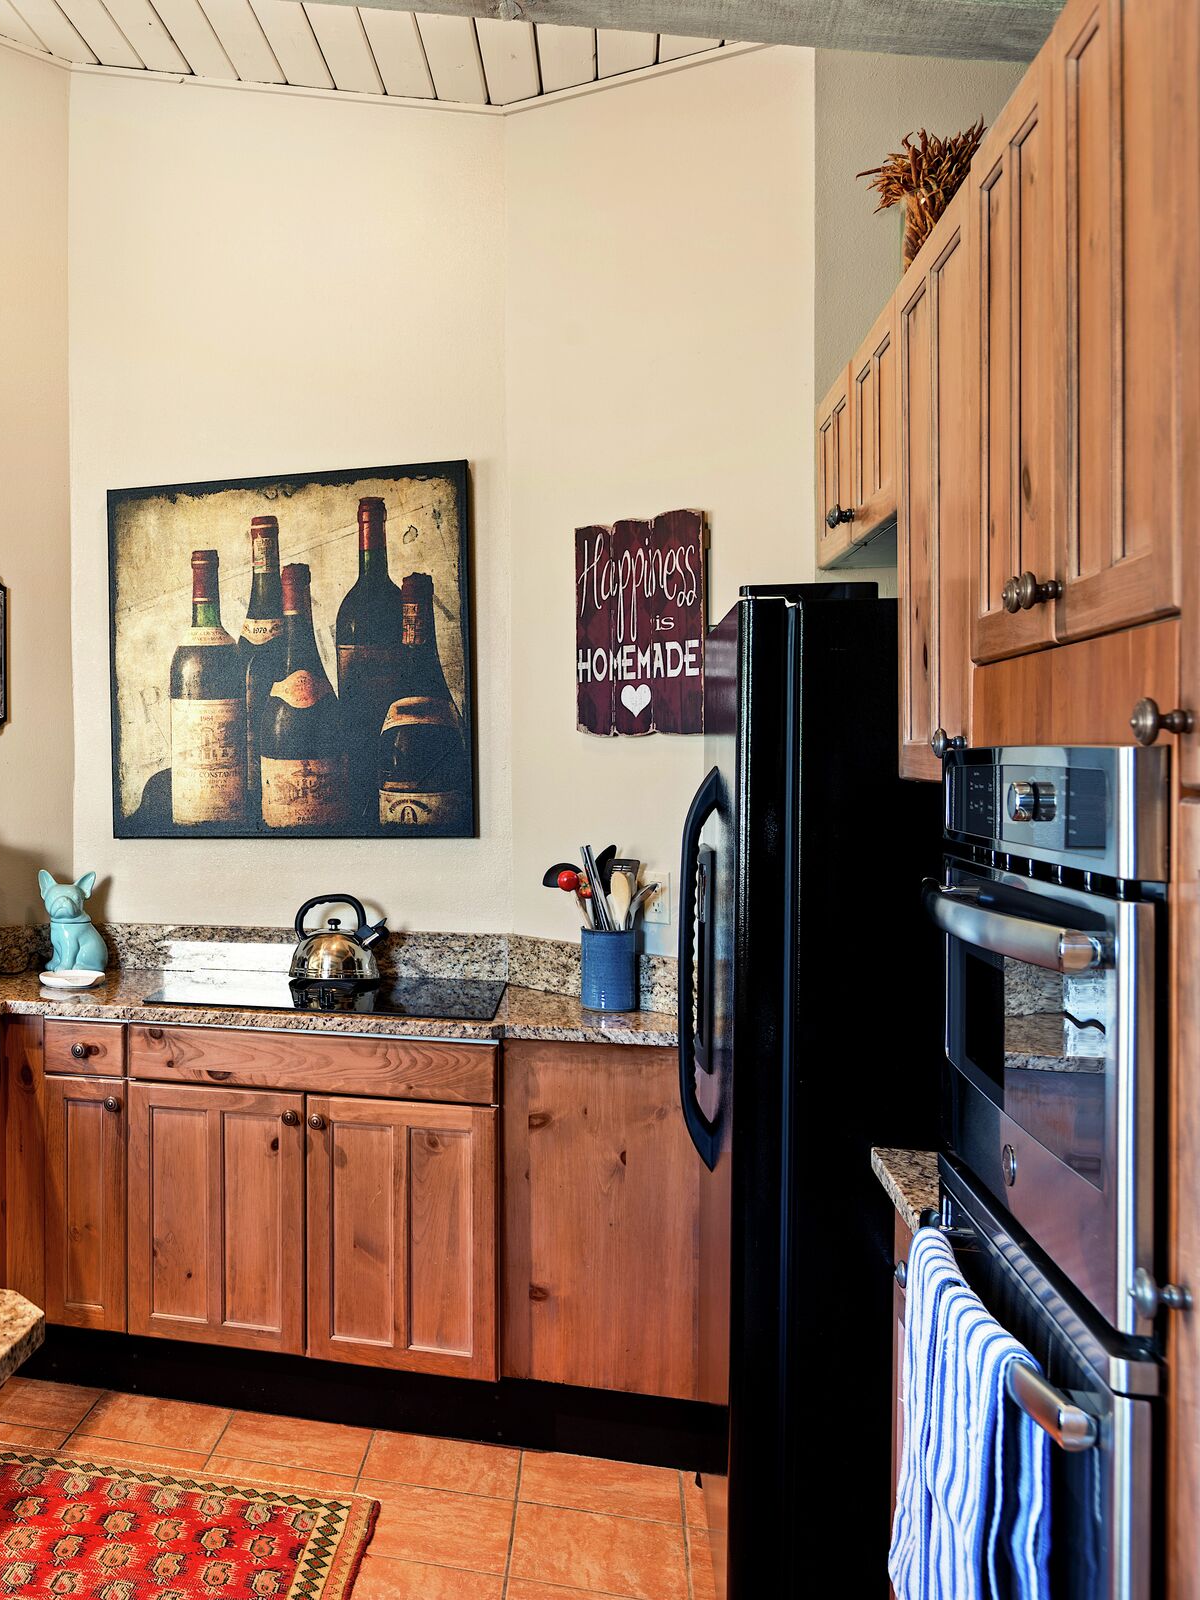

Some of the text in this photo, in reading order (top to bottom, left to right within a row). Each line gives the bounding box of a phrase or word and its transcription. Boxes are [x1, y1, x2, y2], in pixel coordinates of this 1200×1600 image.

[578, 533, 697, 643] Happiness
[655, 615, 674, 631] is
[578, 640, 700, 682] HOMEMADE
